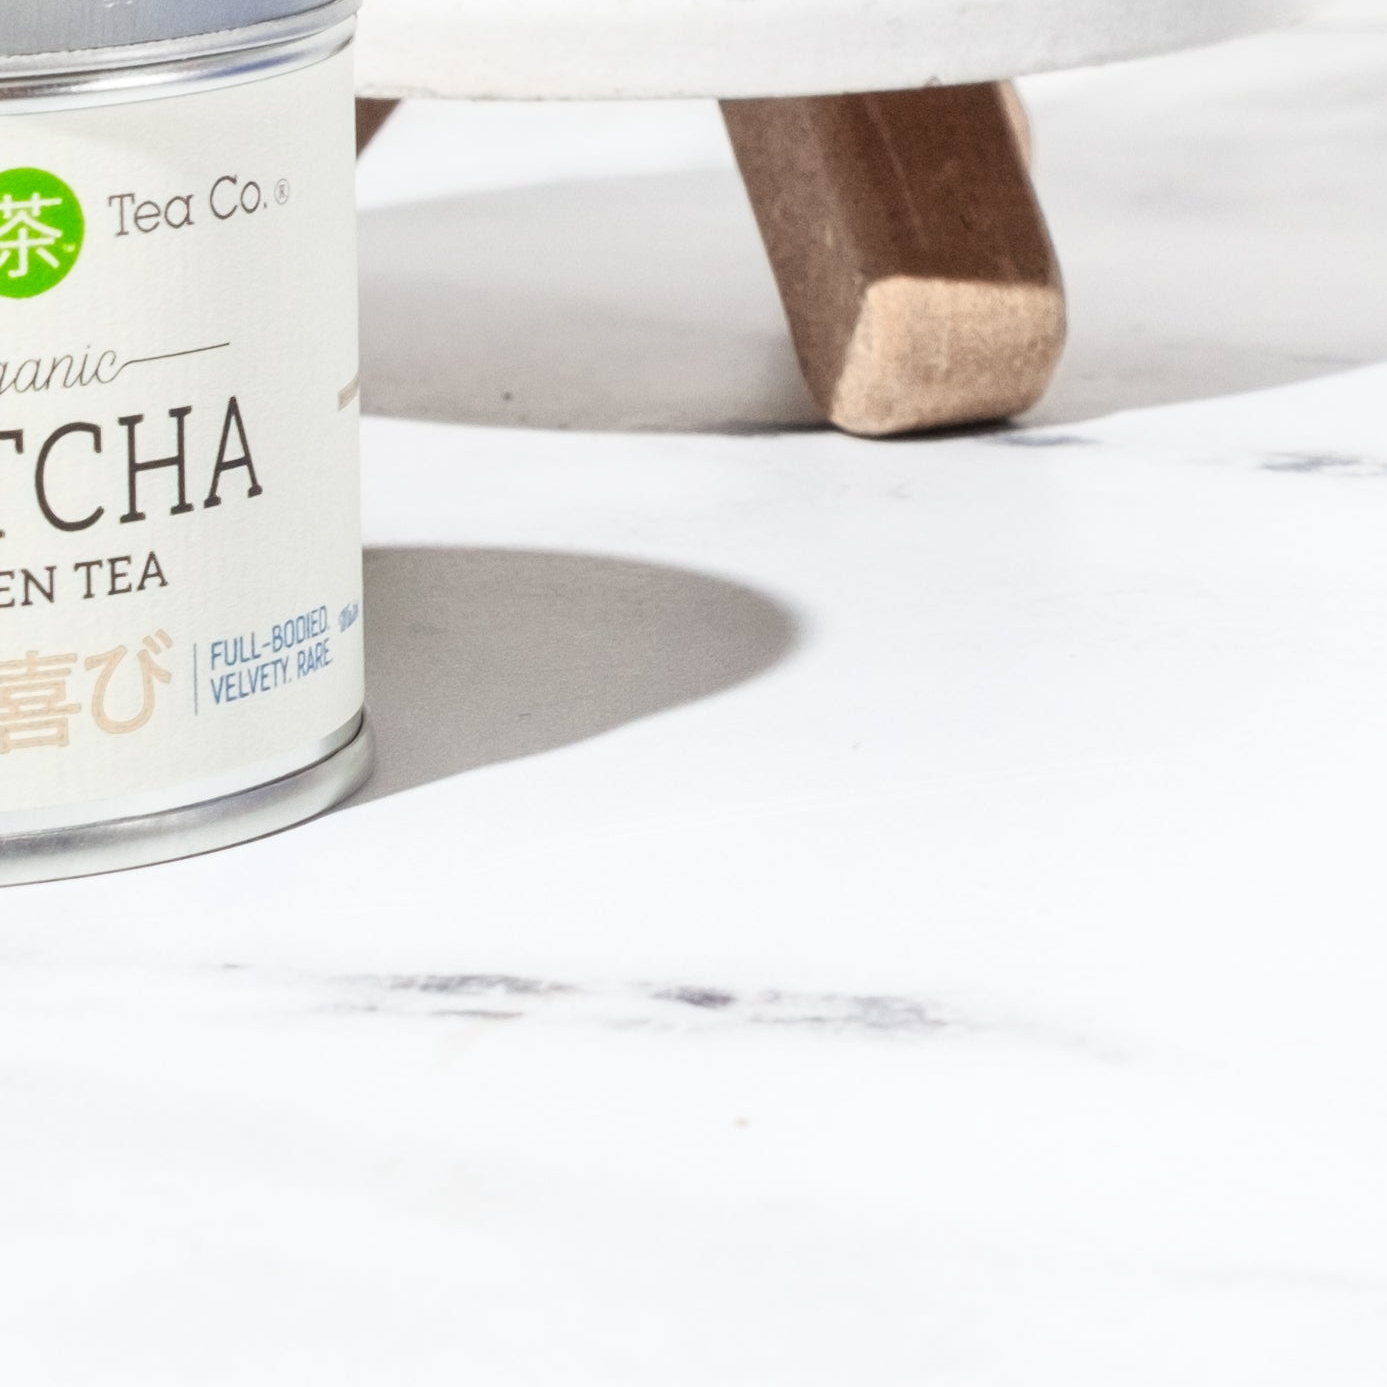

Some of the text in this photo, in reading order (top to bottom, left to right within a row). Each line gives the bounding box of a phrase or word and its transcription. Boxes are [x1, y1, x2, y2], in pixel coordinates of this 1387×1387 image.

[0, 191, 63, 279] 茶
[108, 192, 195, 237] Tea
[74, 550, 169, 599] TEA
[297, 637, 334, 680] RARE
